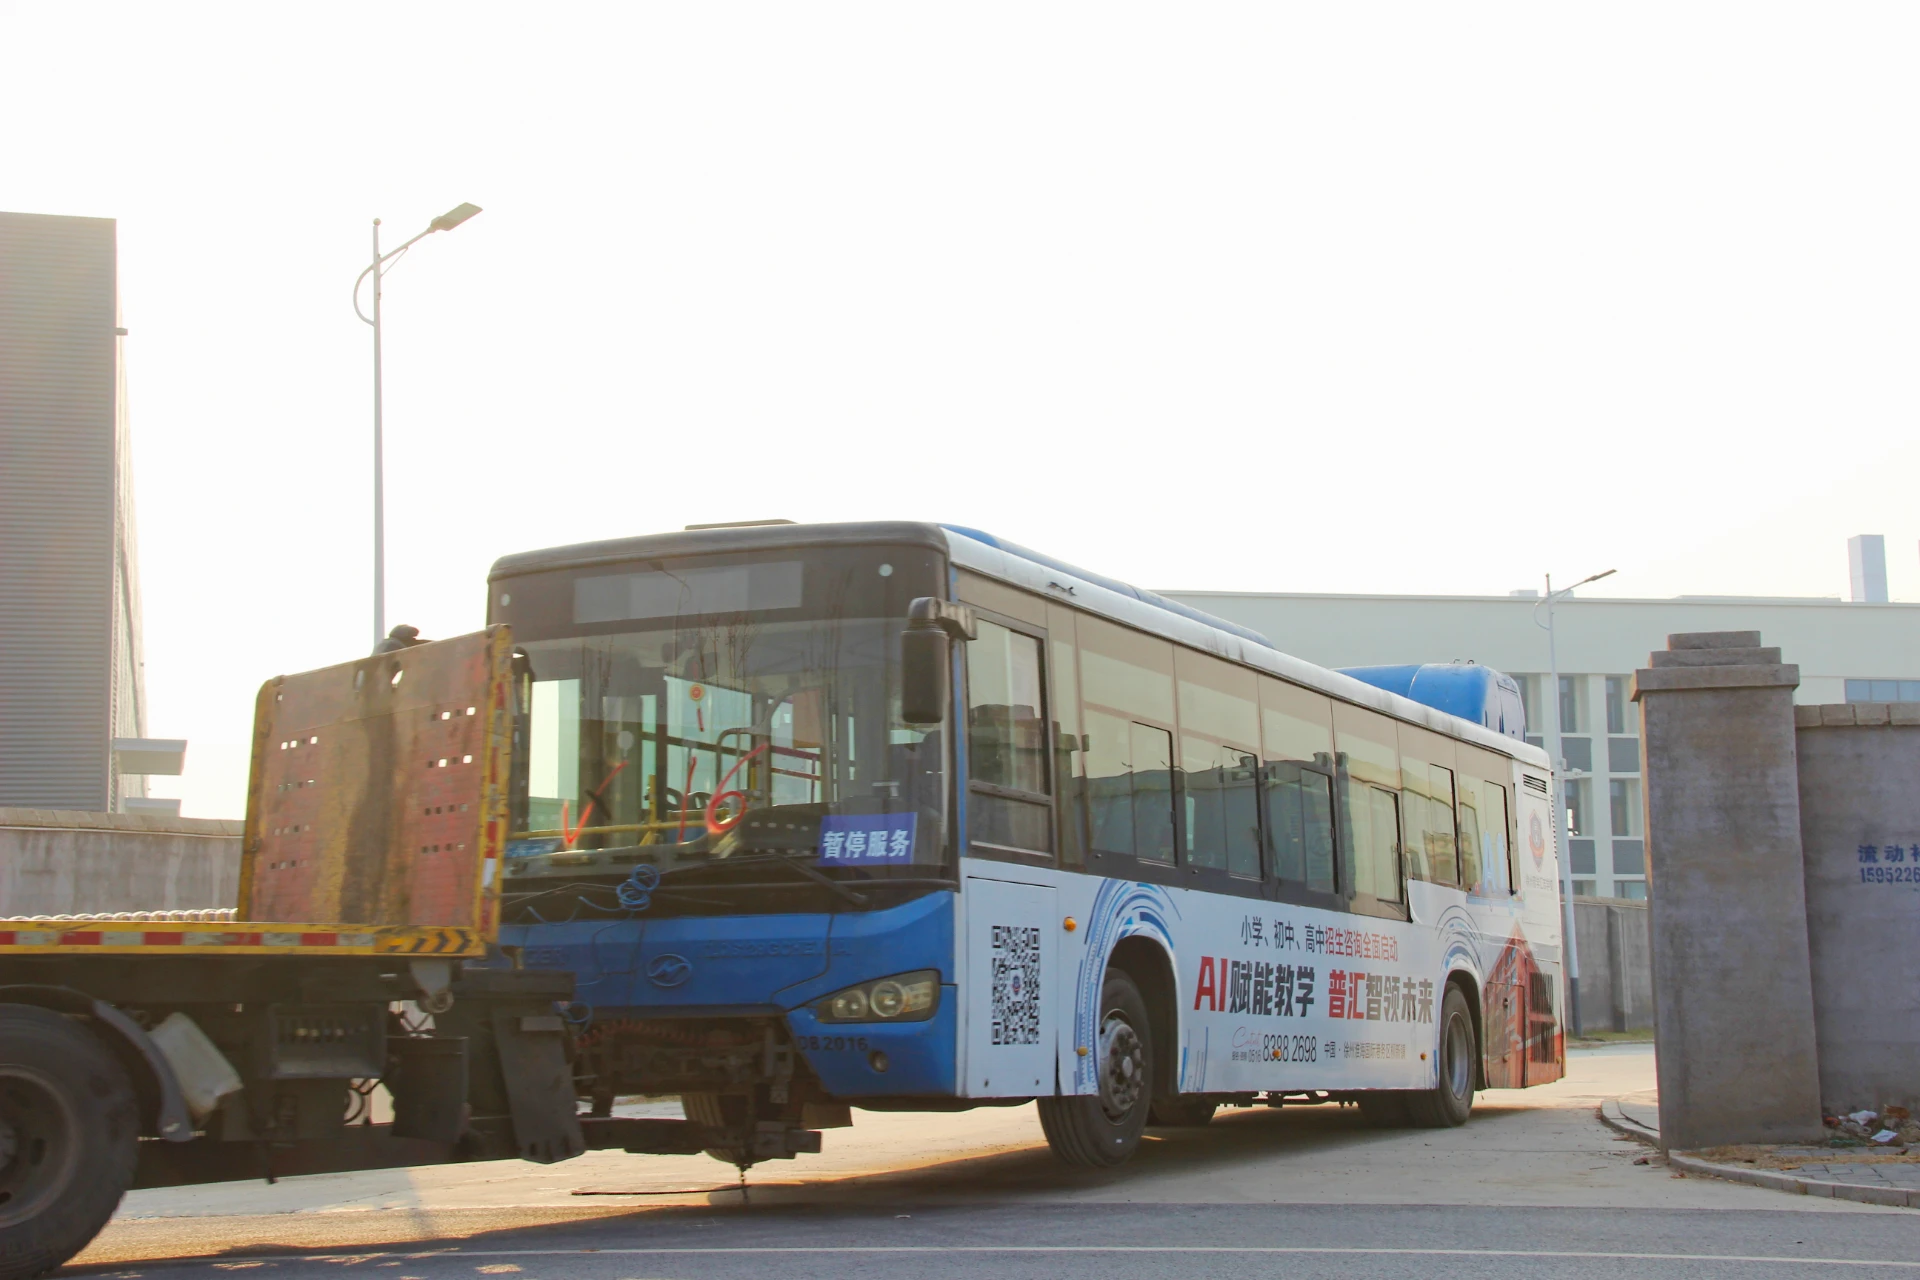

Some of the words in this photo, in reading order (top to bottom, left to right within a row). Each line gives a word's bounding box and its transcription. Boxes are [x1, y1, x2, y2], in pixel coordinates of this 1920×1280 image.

[823, 829, 911, 859] 暂停服务
[1241, 915, 1398, 962] 小学、初中、高中招生咨询全面启动
[1194, 956, 1315, 1018] AI赋能教学
[1328, 969, 1434, 1024] 普汇智领未来
[1291, 1035, 1317, 1062] 2698
